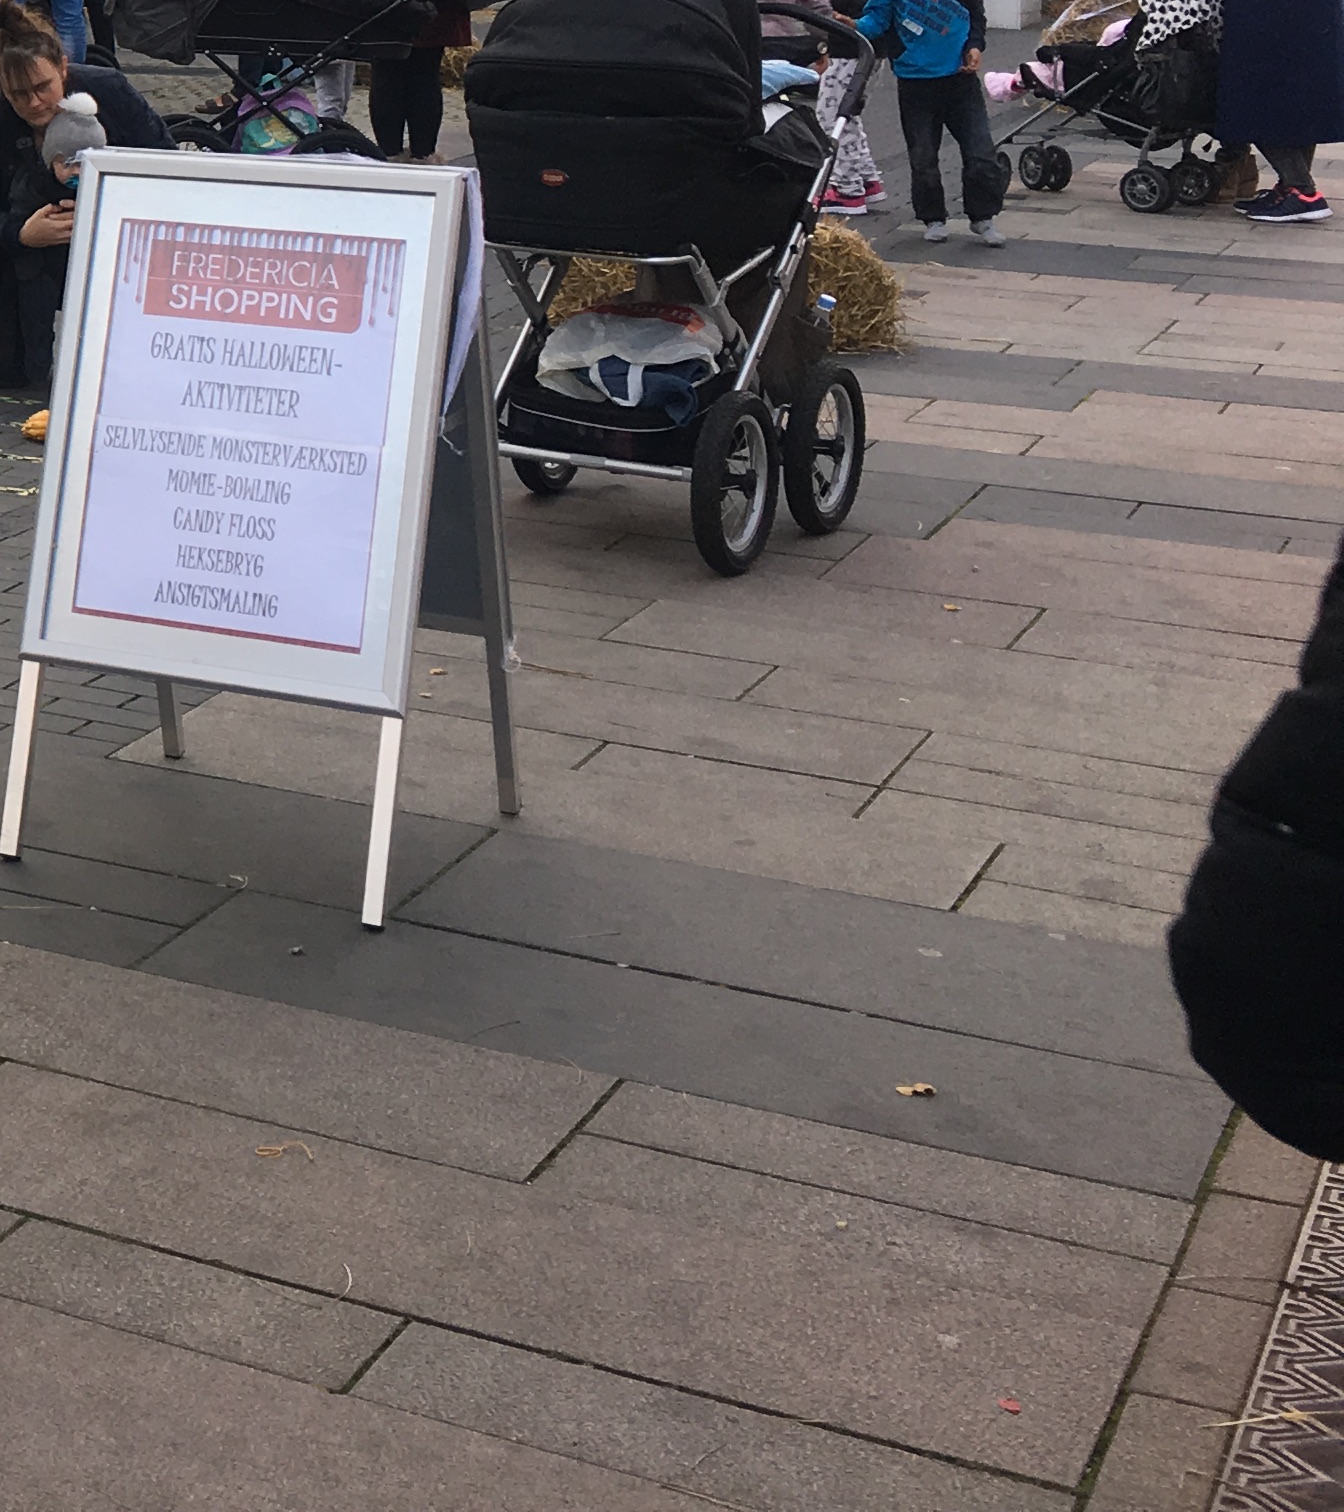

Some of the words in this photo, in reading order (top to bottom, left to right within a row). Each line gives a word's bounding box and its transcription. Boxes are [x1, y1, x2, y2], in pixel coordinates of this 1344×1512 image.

[171, 250, 340, 290] FREDERICIA
[168, 283, 340, 324] SHOPPING
[150, 331, 217, 365] GRATIS
[220, 338, 343, 377] HALLOWEEN-
[180, 380, 301, 419] AKTIVITETER
[103, 424, 207, 459] SELVLYSENDE
[209, 435, 368, 476] MONSTERVÆRKSTED
[172, 506, 226, 536] CANDY
[227, 512, 277, 542] FLOSS
[174, 543, 265, 578] HEKSEBRYG
[153, 579, 279, 619] ANSIGTSMALING
